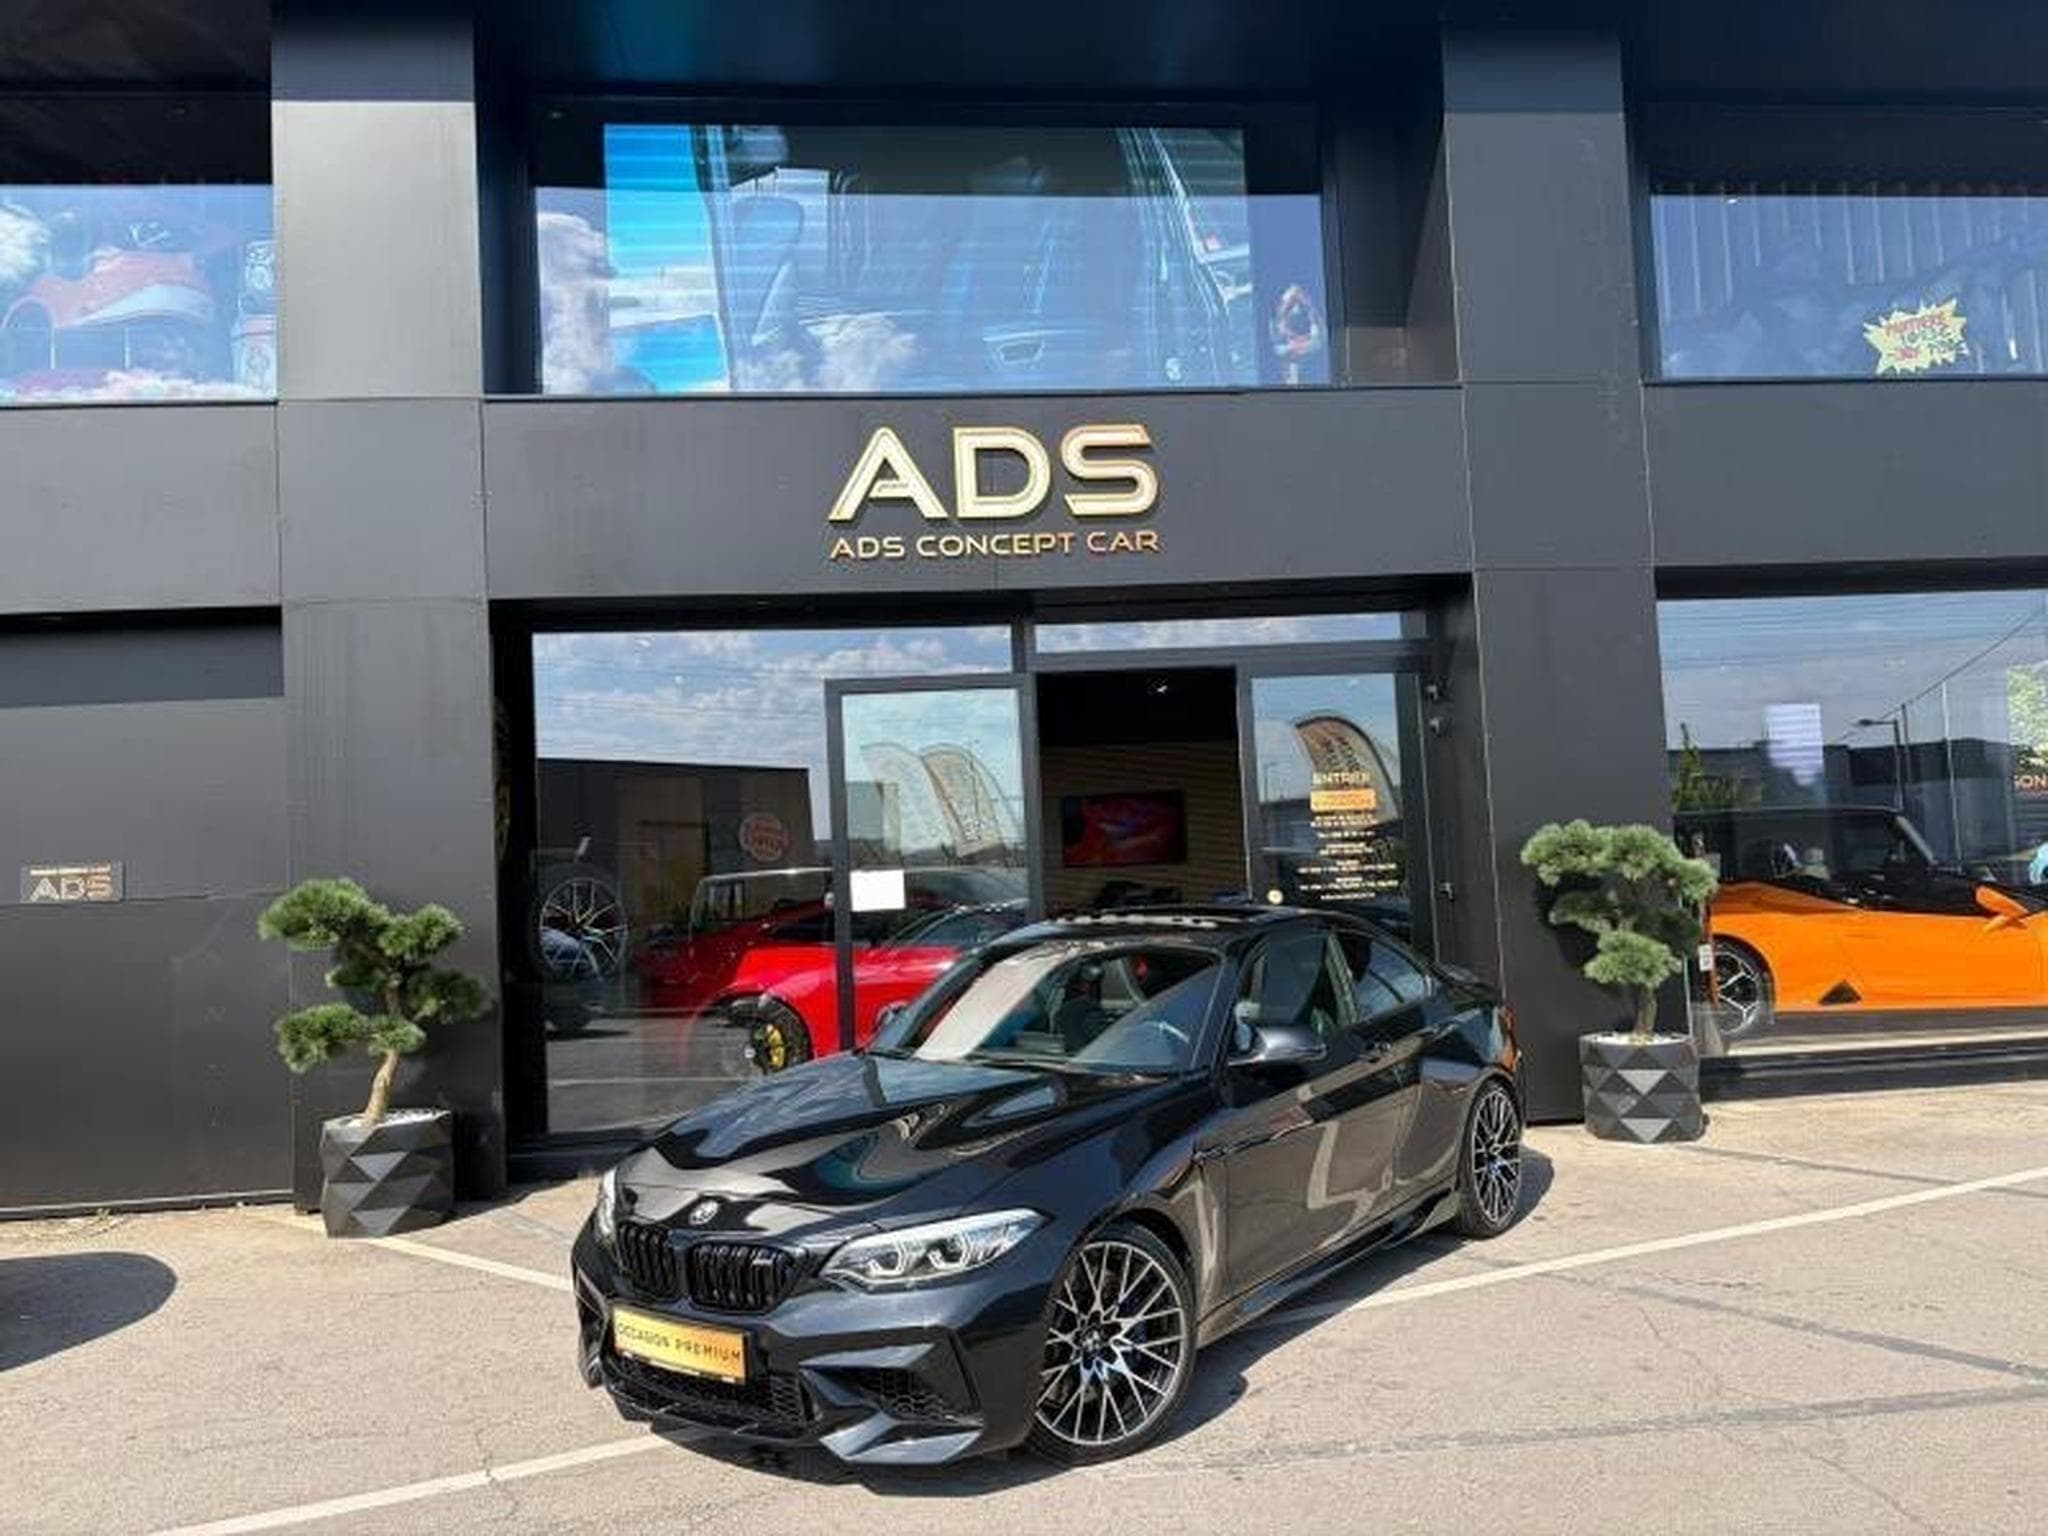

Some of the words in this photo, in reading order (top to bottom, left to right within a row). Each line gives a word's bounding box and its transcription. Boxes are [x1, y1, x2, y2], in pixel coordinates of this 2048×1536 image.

[828, 423, 1159, 521] ADS
[829, 536, 905, 559] ADS
[916, 532, 1076, 557] CONCEPT
[1086, 530, 1161, 553] CAR
[30, 875, 114, 902] ADS
[675, 1338, 744, 1362] PREMIUM
